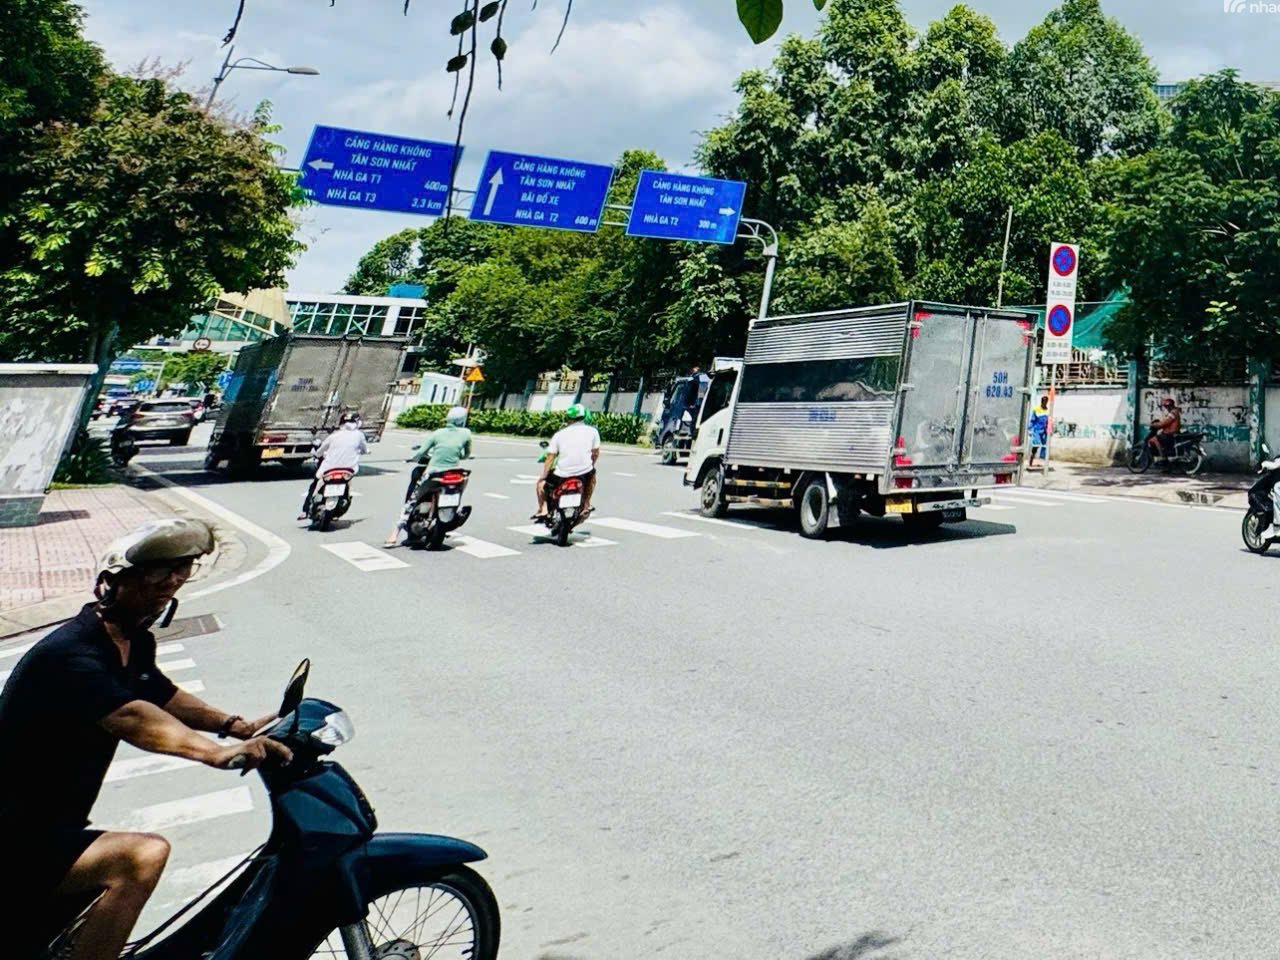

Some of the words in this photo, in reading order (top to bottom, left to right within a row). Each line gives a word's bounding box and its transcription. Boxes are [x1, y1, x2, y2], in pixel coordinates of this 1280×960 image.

[372, 140, 398, 154] HÀNG
[400, 144, 432, 158] KHÔNG
[351, 154, 368, 166] TÂN
[332, 169, 353, 181] NHÀ
[355, 172, 368, 183] GA
[326, 187, 348, 201] NHÀ
[350, 190, 362, 202] GA
[364, 191, 377, 203] T3
[548, 195, 560, 205] XE
[427, 198, 442, 209] km
[534, 211, 545, 221] GA
